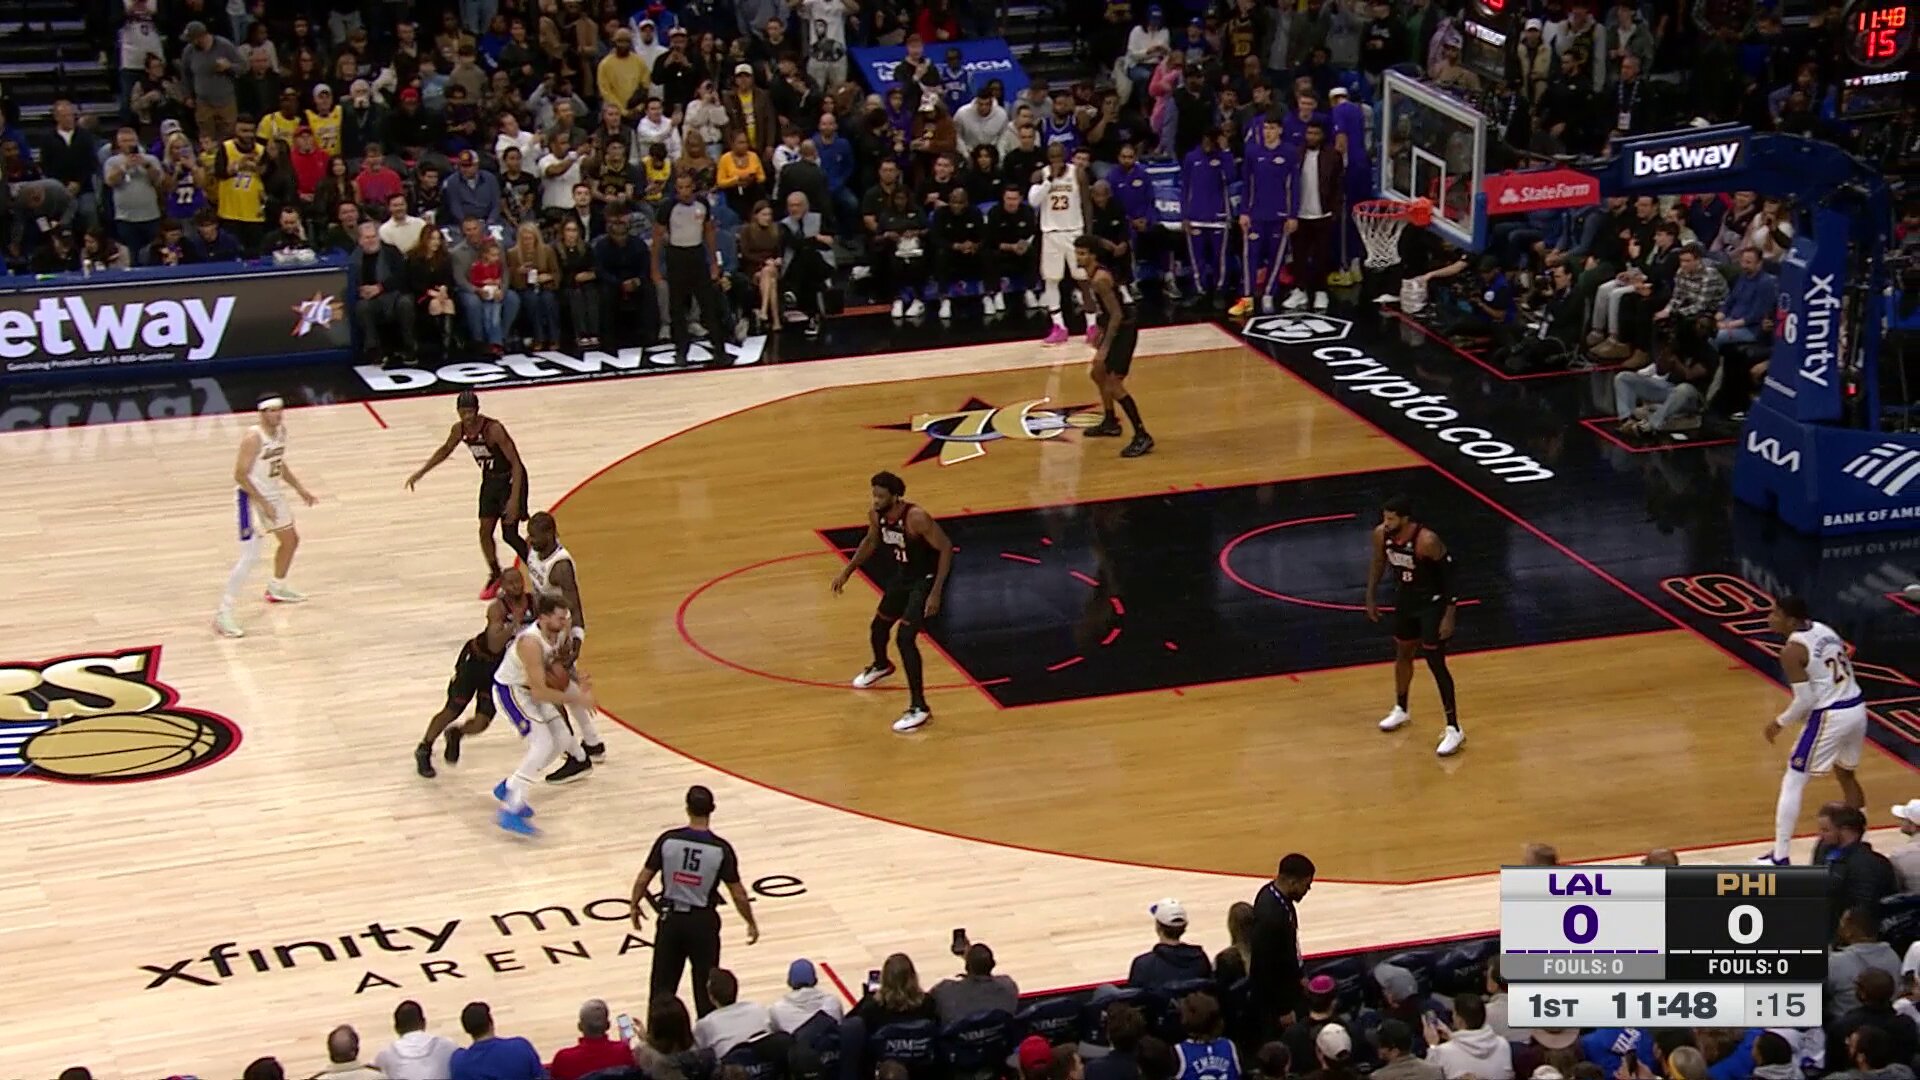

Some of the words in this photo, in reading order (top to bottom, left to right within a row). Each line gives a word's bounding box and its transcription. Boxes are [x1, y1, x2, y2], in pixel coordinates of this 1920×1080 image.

[1868, 29, 1896, 57] 15
[1633, 142, 1739, 177] betway
[1051, 195, 1069, 211] 23
[0, 296, 236, 360] etway
[1799, 273, 1841, 387] xfinity
[353, 335, 767, 392] betway
[1312, 346, 1555, 483] crypto.com
[1823, 511, 1865, 527] BANK
[1867, 508, 1889, 523] OF
[894, 548, 909, 563] 21
[1402, 571, 1414, 583] 8
[683, 846, 703, 872] 15
[139, 919, 461, 990] xfinity
[490, 874, 808, 937] moe
[354, 933, 656, 994] ARENA
